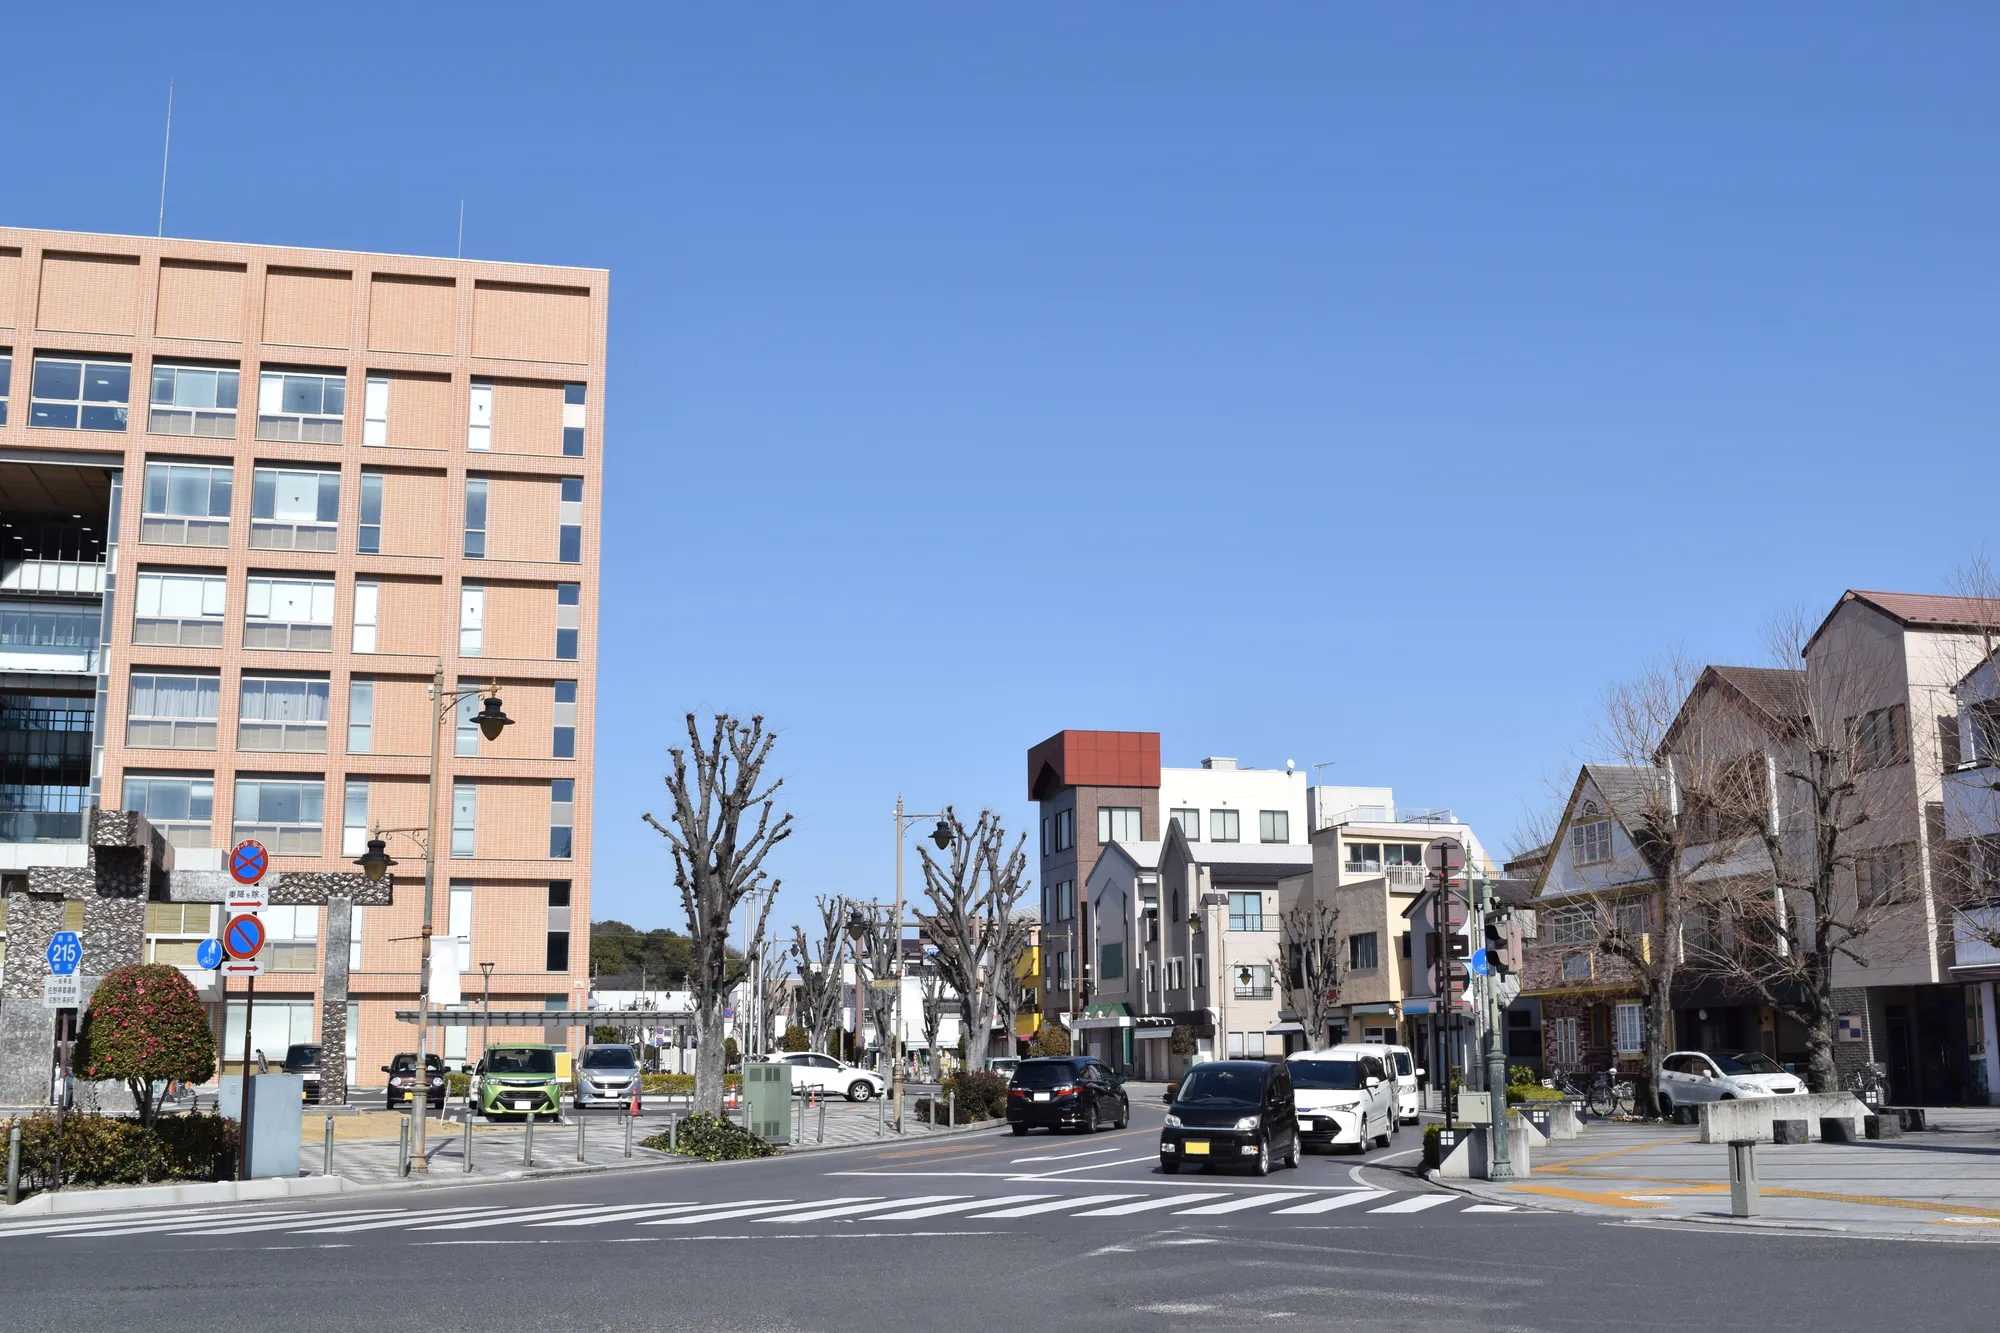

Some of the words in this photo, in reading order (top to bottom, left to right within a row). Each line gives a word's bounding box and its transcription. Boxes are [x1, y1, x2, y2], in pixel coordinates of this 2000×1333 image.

[228, 890, 265, 899] 乗降を除く
[52, 944, 76, 962] 215
